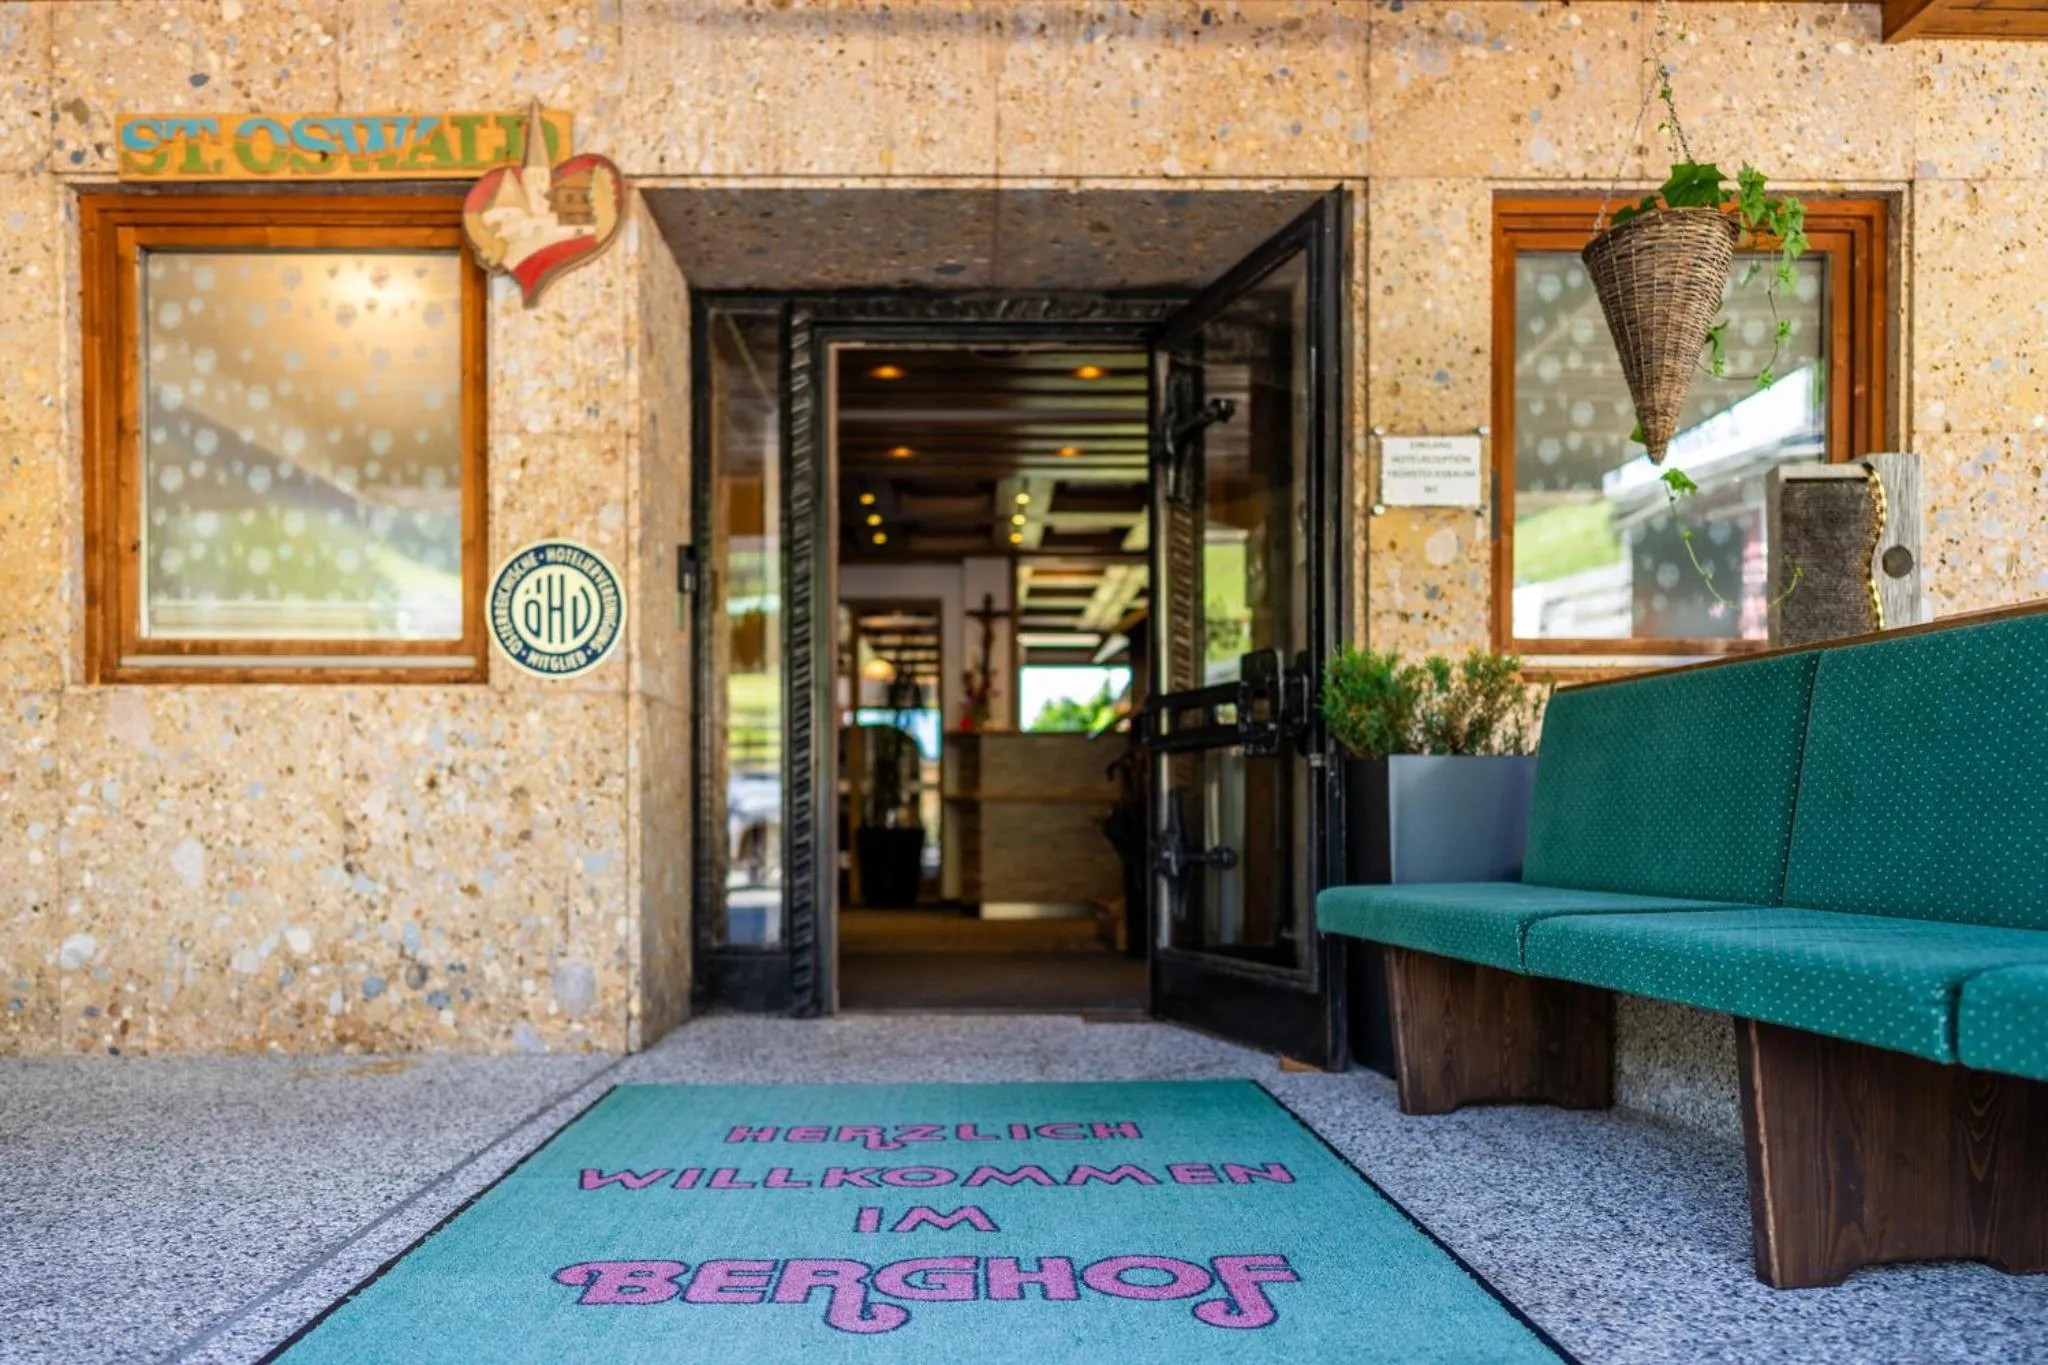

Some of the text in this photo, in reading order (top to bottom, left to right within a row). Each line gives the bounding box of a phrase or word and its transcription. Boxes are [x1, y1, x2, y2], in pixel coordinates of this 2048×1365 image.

[120, 116, 559, 176] ST. OSWALD
[526, 649, 588, 671] MITGLIED
[723, 1120, 1144, 1152] HERZLICH
[579, 1161, 1298, 1191] WILLKOMMEN
[852, 1204, 1001, 1234] IM
[552, 1253, 1301, 1335] BERGHOF
